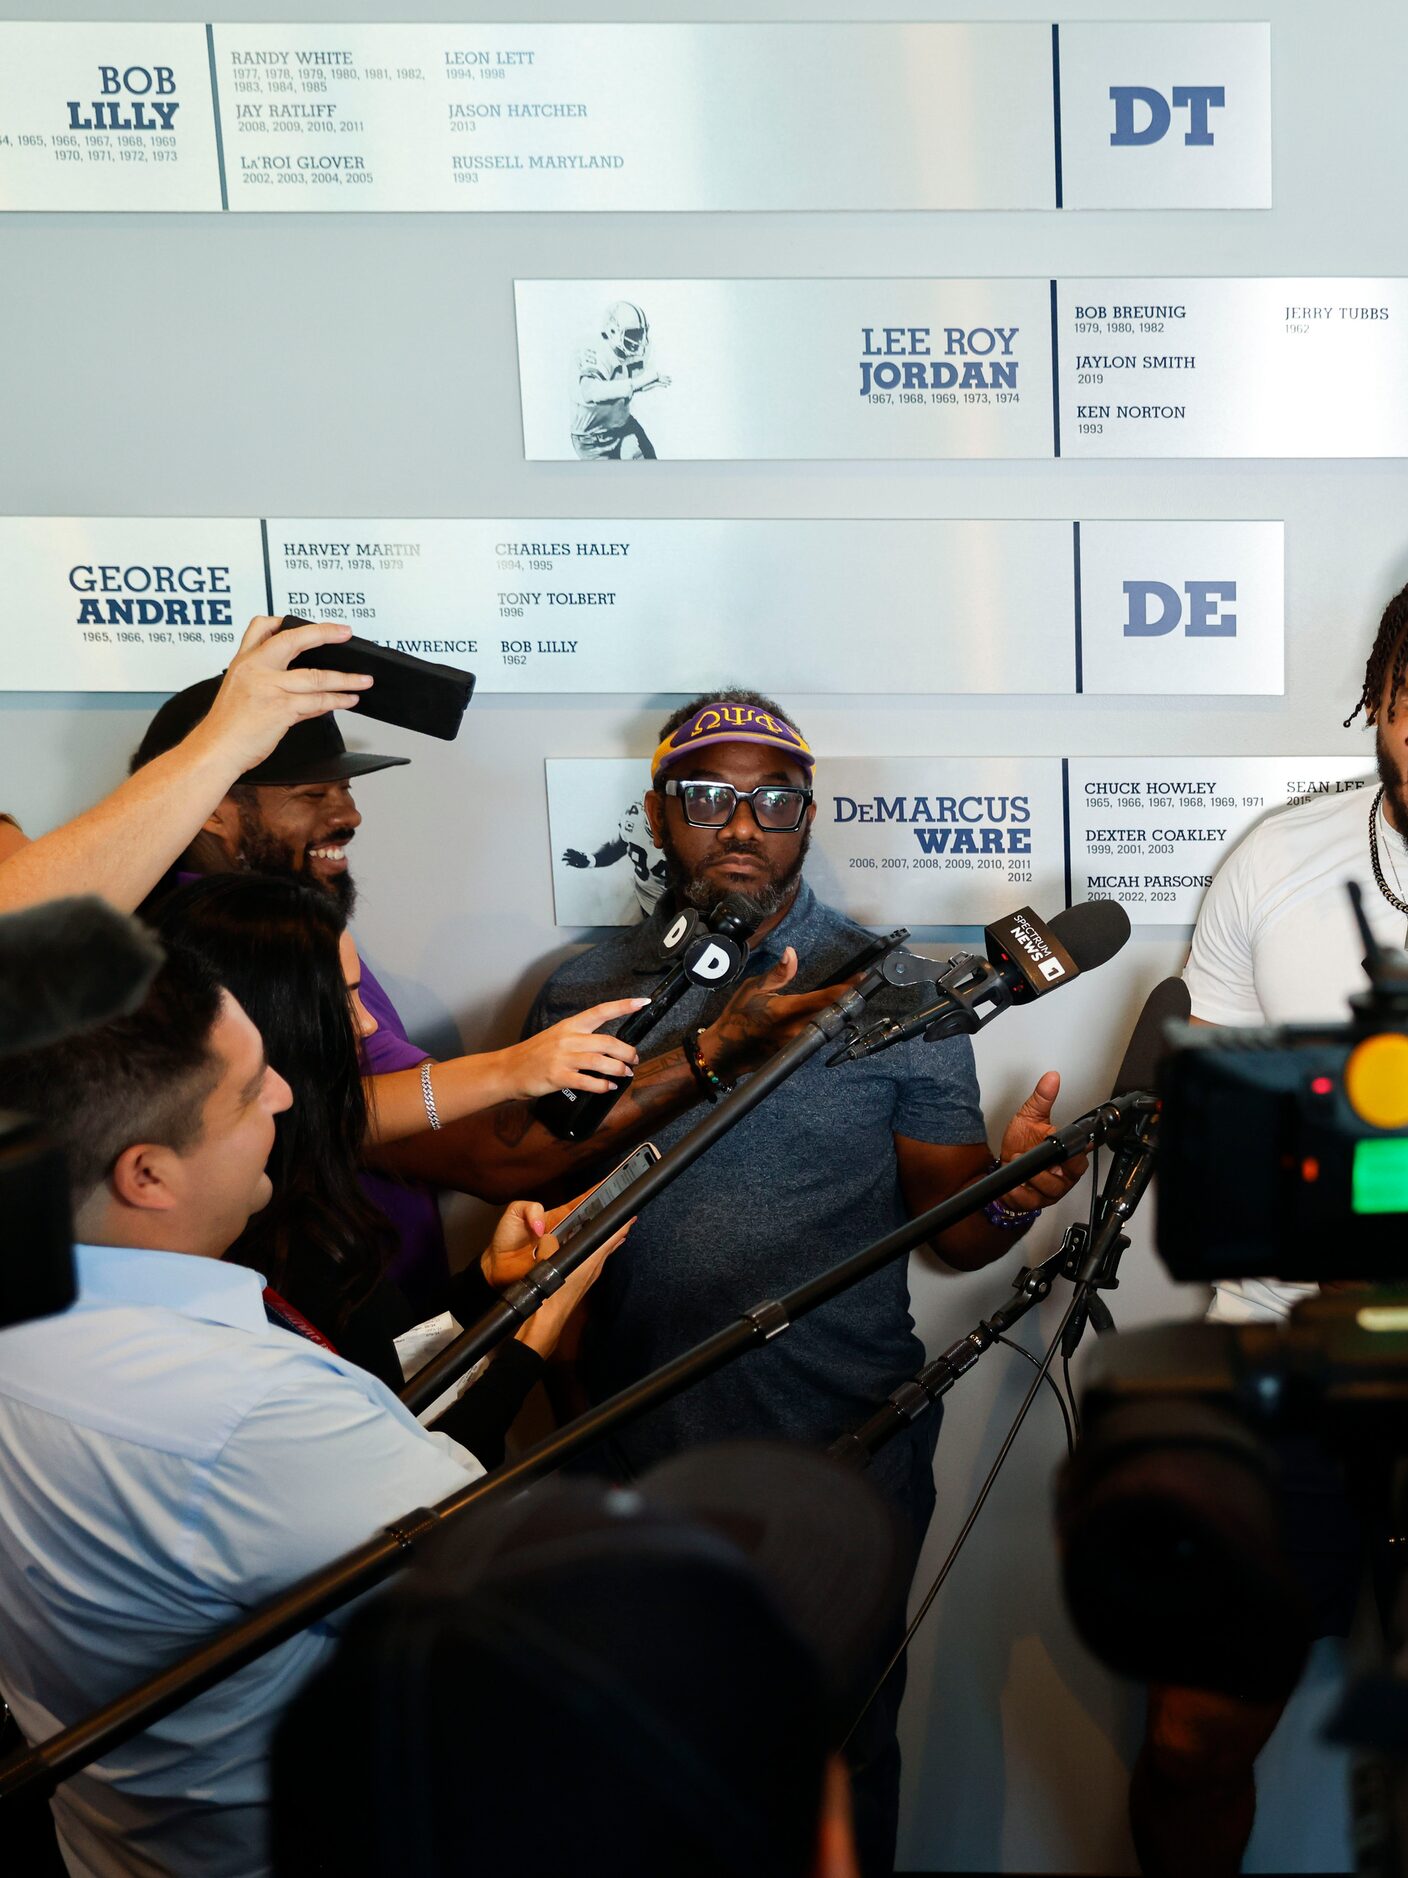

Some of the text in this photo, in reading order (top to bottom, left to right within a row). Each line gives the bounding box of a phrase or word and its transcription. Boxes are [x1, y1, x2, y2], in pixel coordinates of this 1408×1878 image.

[231, 52, 353, 64] RANDY WHITE
[445, 52, 535, 64] LEON LETT
[99, 66, 176, 94] BOB
[233, 69, 425, 80] 1977, 1978, 1979, 1980, 1981, 1982,
[235, 82, 327, 93] 1983, 1984, 1985
[67, 102, 179, 130] LILLY
[236, 104, 337, 118] JAY RATLIFF
[449, 104, 587, 118] JASON HATCHER
[1109, 86, 1225, 146] DT
[238, 122, 364, 132] 2008, 2009, 2010, 2011
[18, 136, 176, 147] 1965, 1966, 1967, 1968, 1969
[55, 151, 177, 162] 1970, 1971, 1972, 1973
[453, 156, 624, 169] RUSSELL MARYLAND
[297, 157, 365, 169] GLOVER
[243, 173, 373, 184] 2002, 2003, 2004, 2005
[1075, 306, 1186, 319] BOB BREUNIG
[1285, 307, 1389, 320] JERRY TUBBS
[1075, 323, 1164, 334] 1979, 1980, 1982
[862, 328, 1019, 356] LEE ROY
[1076, 356, 1196, 370] JAYLON SMITH
[860, 361, 1019, 396] JORDAN
[1078, 374, 1103, 384] 2019
[868, 393, 1019, 405] 1967, 1968, 1969, 1973, 1974
[1077, 406, 1185, 418] KEN NORTON
[1079, 424, 1103, 433] 1993
[284, 544, 421, 556] HARVEY MARTIN
[495, 544, 630, 556] CHARLES HALEY
[285, 560, 312, 571] 1976,
[317, 560, 343, 571] 1977,
[348, 560, 374, 571] 1978,
[529, 560, 552, 571] 1995
[69, 566, 231, 592] GEORGE
[288, 593, 365, 605] ED JONES
[498, 593, 616, 605] TONY TOLBERT
[77, 599, 232, 625] ANDRIE
[320, 608, 347, 619] 1982,
[352, 608, 375, 619] 1983
[499, 608, 523, 617] 1996
[1123, 581, 1236, 637] DE
[83, 632, 234, 643] 1965, 1966, 1967, 1968, 1969
[501, 641, 578, 652] BOB LILLY
[503, 656, 526, 665] 1962
[1085, 783, 1216, 794] CHUCK HOWLEY
[1287, 781, 1329, 793] SEAN
[1086, 798, 1264, 808] 1965, 1966, 1967, 1968, 1969, 1971
[913, 828, 1032, 854] WARE
[1086, 830, 1227, 842] DEXTER COAKLEY
[1087, 845, 1174, 855] 1999, 2001, 2003
[849, 858, 1031, 869] 2006, 2007, 2008, 2009, 2010, 2011
[1008, 873, 1032, 882] 2012
[1088, 876, 1213, 888] MICAH PARSONS
[1119, 892, 1147, 902] 2022,
[1151, 892, 1176, 902] 2023
[663, 915, 687, 948] D
[1014, 915, 1052, 957] SPECTRUM
[1011, 926, 1043, 962] NEWS
[692, 942, 730, 979] D
